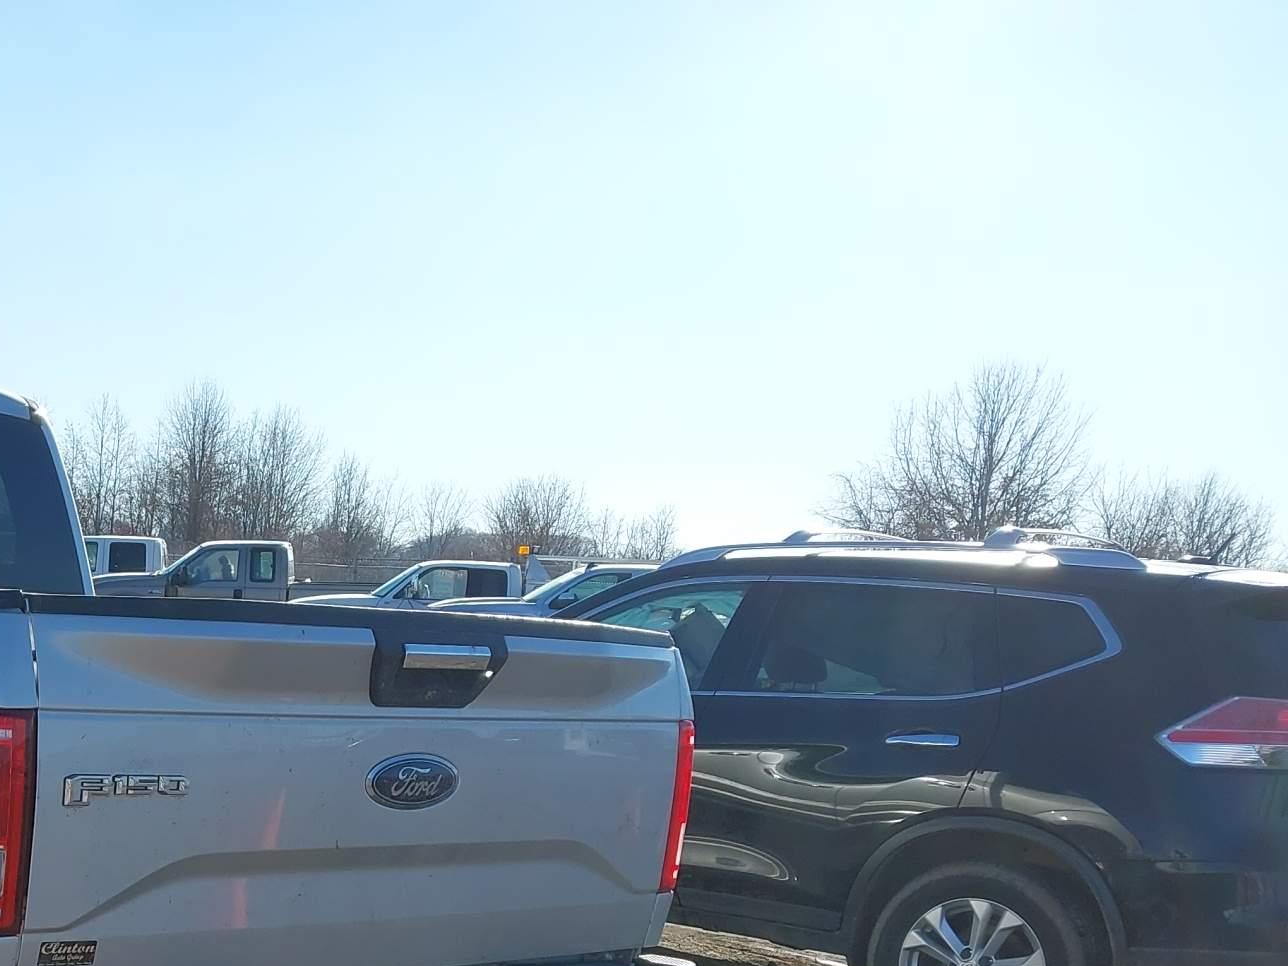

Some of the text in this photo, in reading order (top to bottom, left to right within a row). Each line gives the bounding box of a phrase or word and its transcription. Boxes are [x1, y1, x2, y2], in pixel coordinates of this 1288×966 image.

[62, 774, 191, 807] F150
[391, 765, 443, 796] Ford
[40, 942, 96, 955] Clinton
